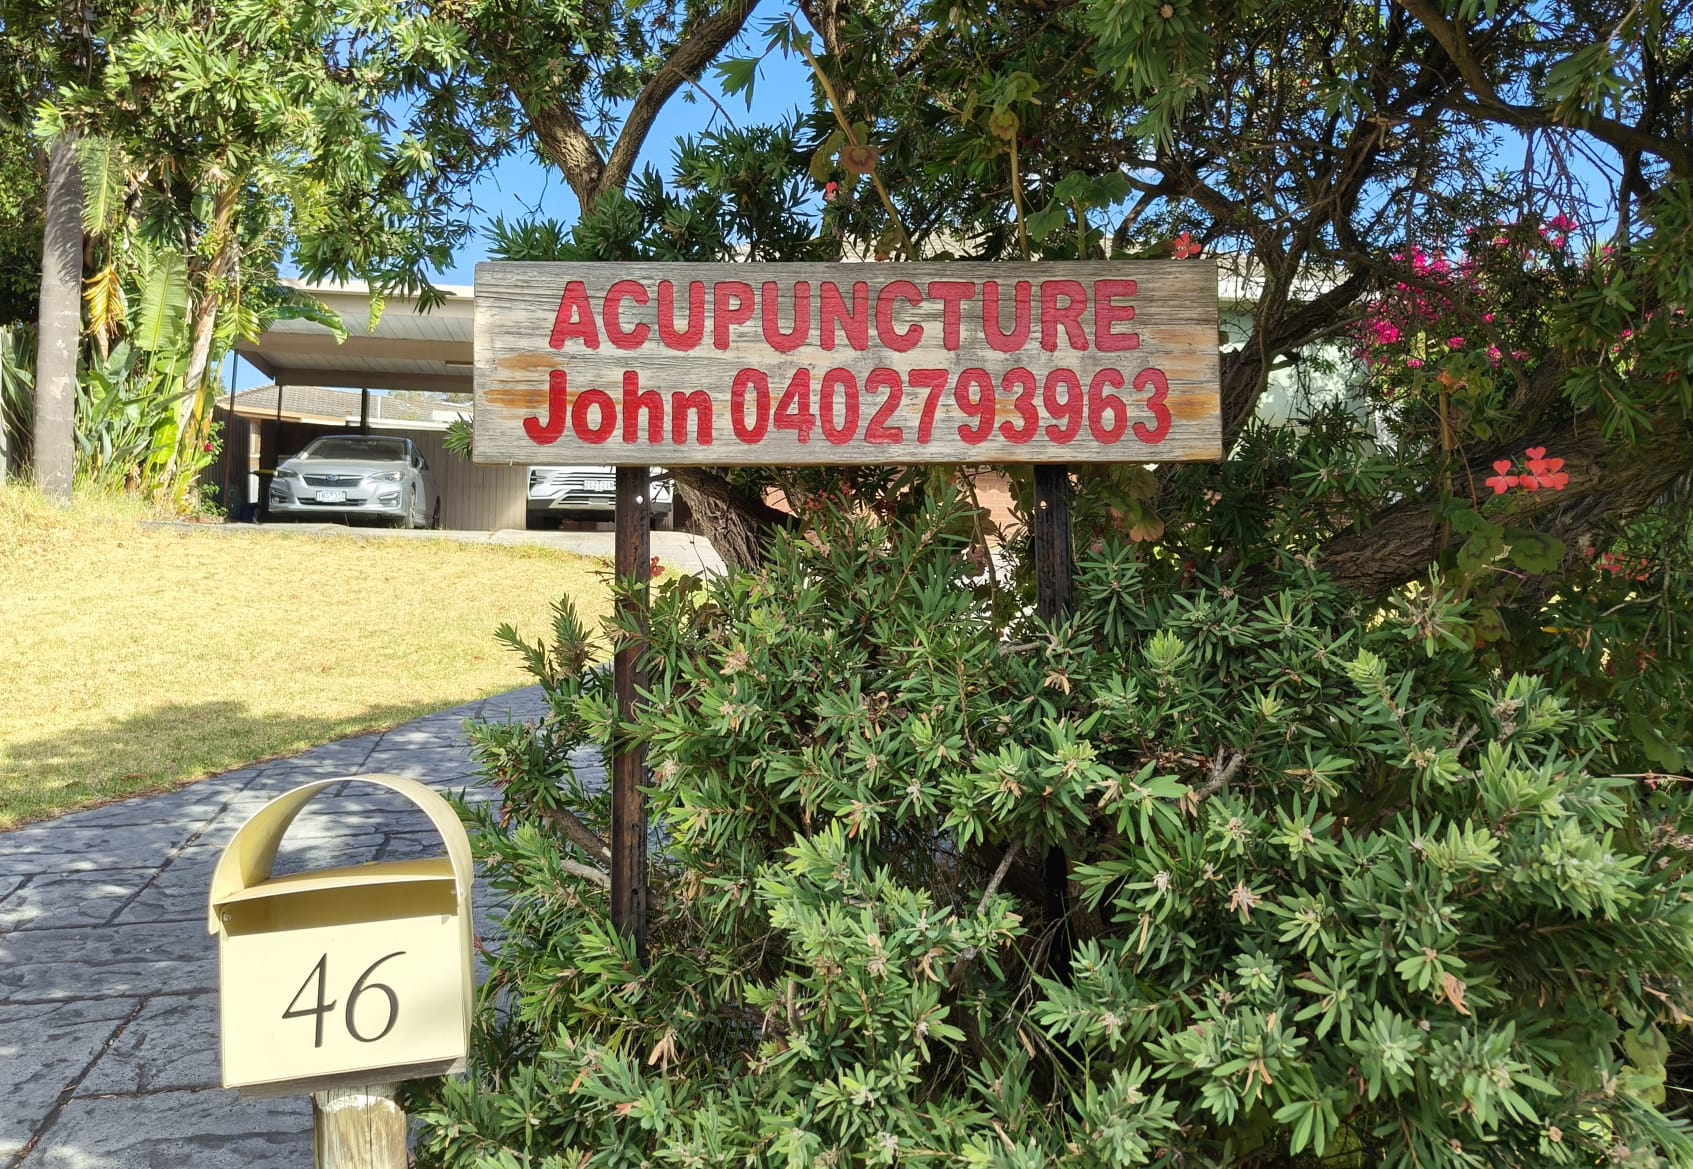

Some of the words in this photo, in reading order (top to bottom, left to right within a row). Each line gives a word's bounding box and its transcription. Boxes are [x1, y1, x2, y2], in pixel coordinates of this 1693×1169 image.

[548, 279, 1141, 353] ACUPUNCTURE
[522, 369, 714, 446] John
[730, 367, 1172, 446] 0402793963
[282, 951, 407, 1048] 46
